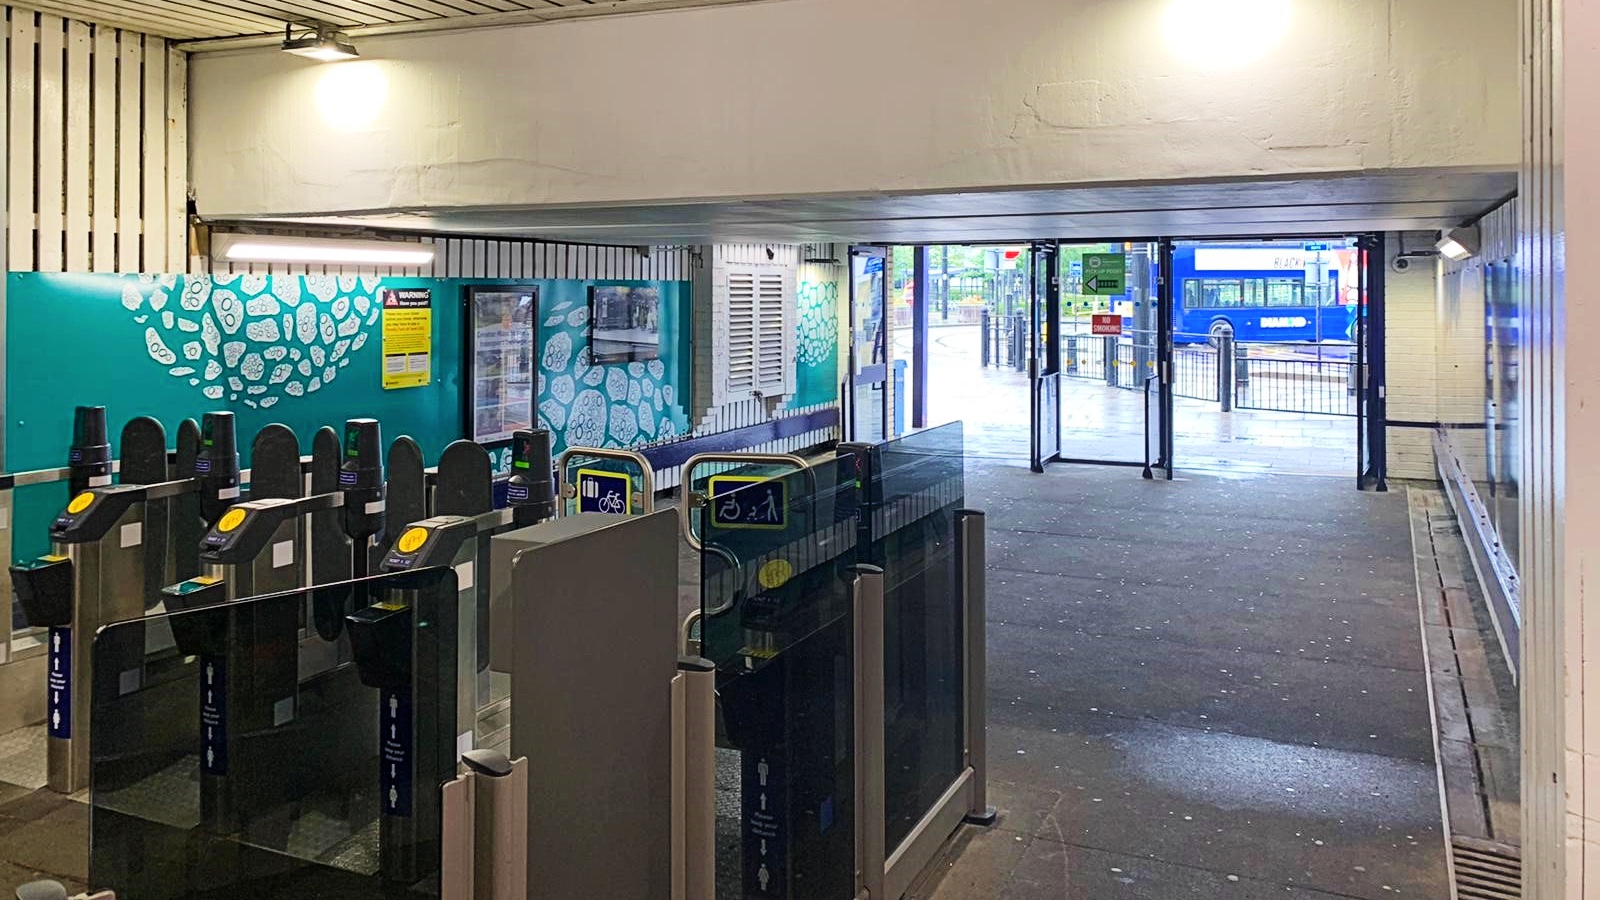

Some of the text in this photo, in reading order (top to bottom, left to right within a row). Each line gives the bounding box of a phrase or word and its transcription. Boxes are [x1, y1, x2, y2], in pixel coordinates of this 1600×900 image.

[399, 291, 429, 299] WARNING
[1102, 316, 1111, 324] NO
[1260, 317, 1306, 328] DIAMOND
[1094, 325, 1120, 333] SMOKING
